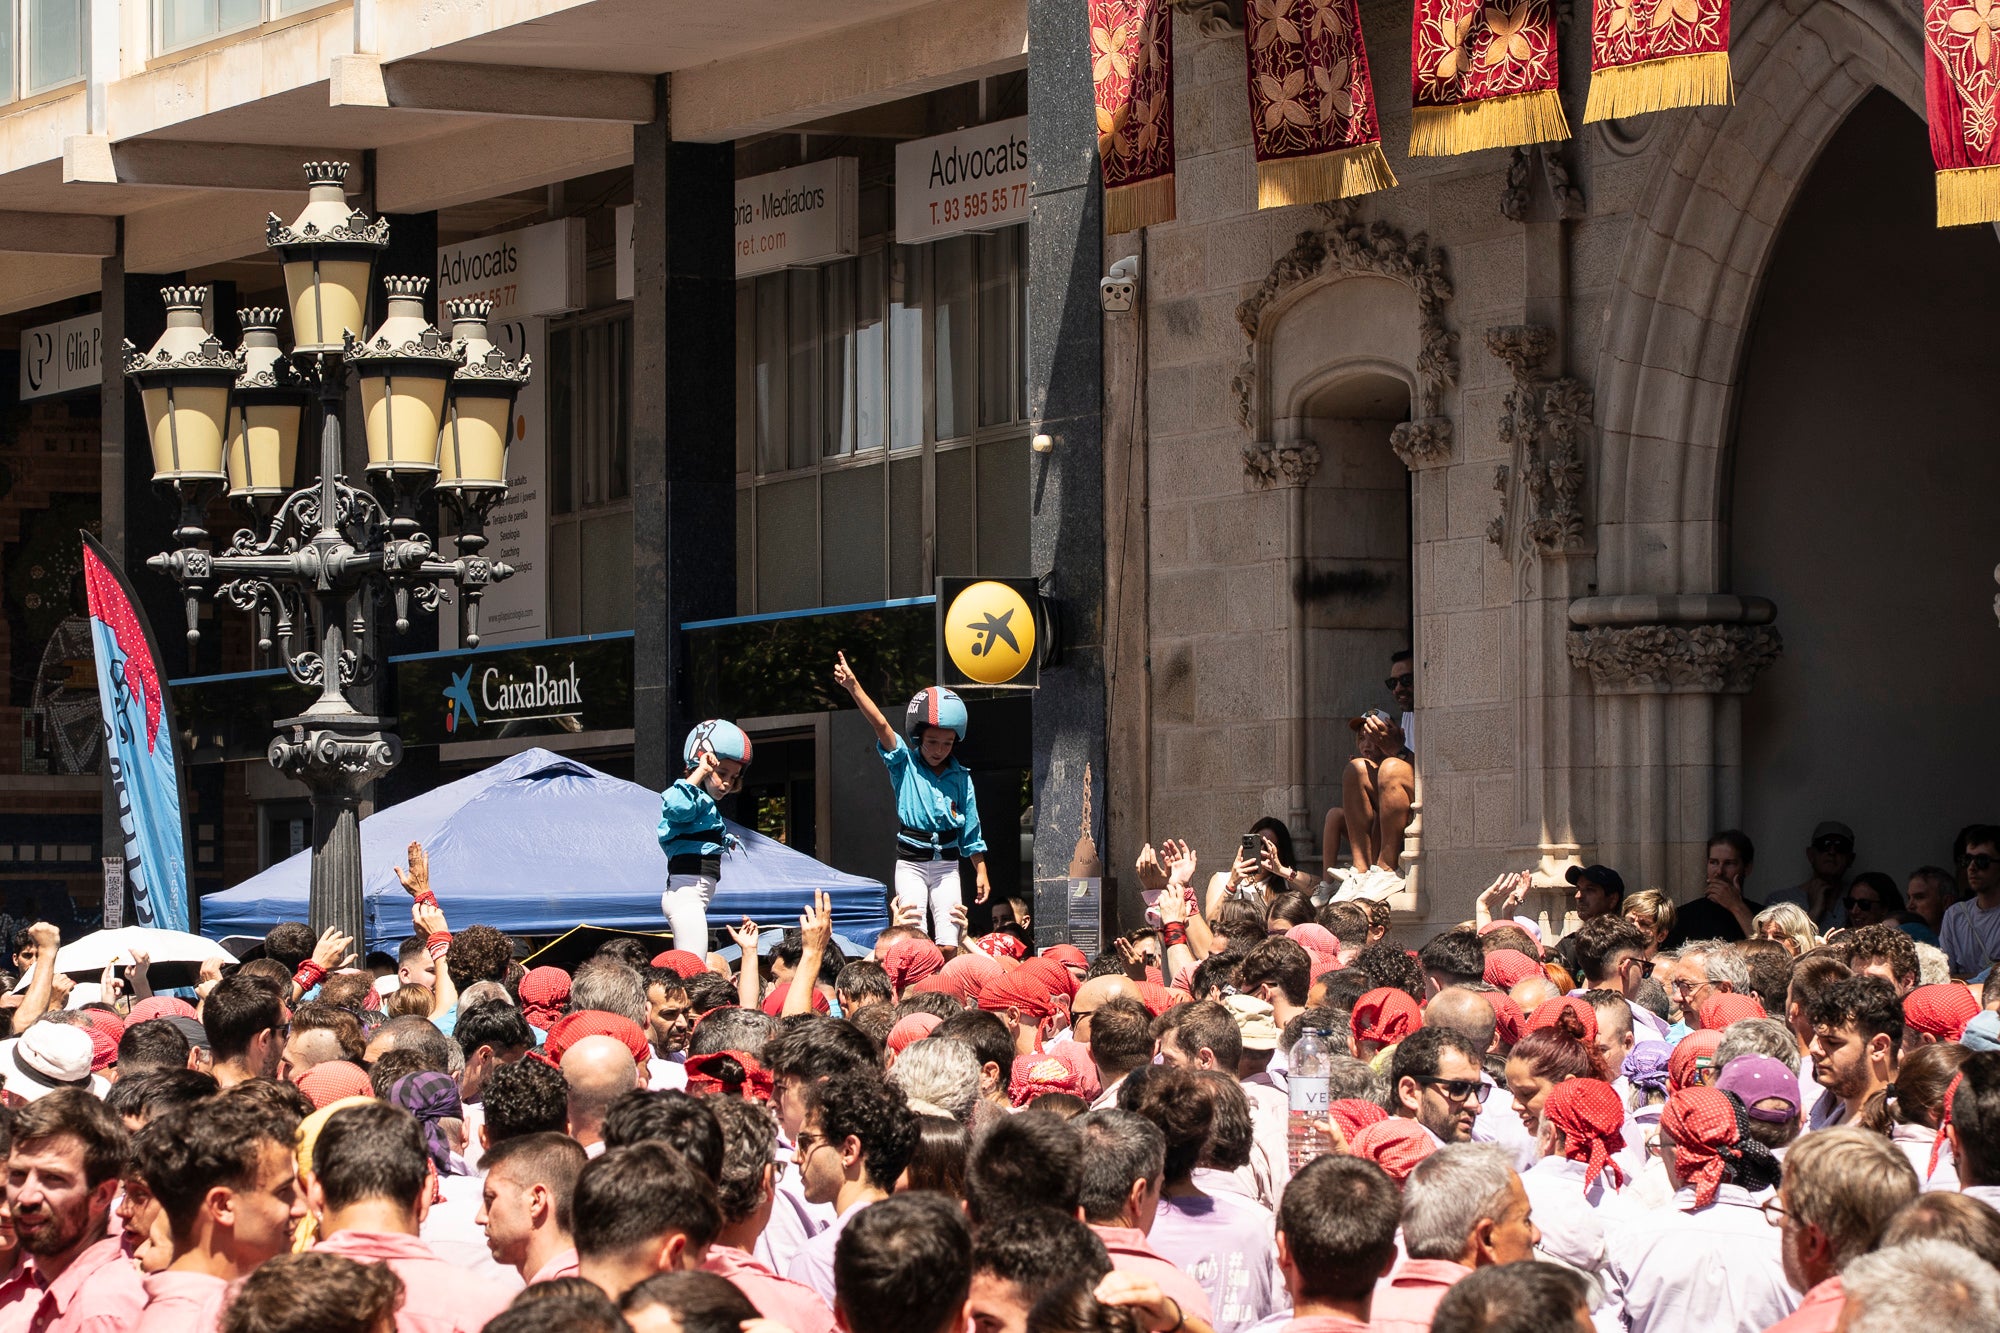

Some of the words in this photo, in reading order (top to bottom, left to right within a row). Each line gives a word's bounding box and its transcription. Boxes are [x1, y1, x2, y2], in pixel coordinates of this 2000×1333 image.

[929, 134, 1028, 189] Advocats
[762, 185, 824, 221] Mediadors
[929, 202, 940, 226] T.
[944, 198, 960, 223] 93
[964, 192, 988, 218] 595
[992, 188, 1008, 213] 55
[1012, 183, 1027, 209] 77
[439, 241, 517, 289] Advocats
[738, 231, 787, 257] ret.com
[504, 284, 517, 306] 77
[66, 331, 89, 372] Glia
[93, 327, 102, 367] P
[482, 661, 583, 712] CaixaBank
